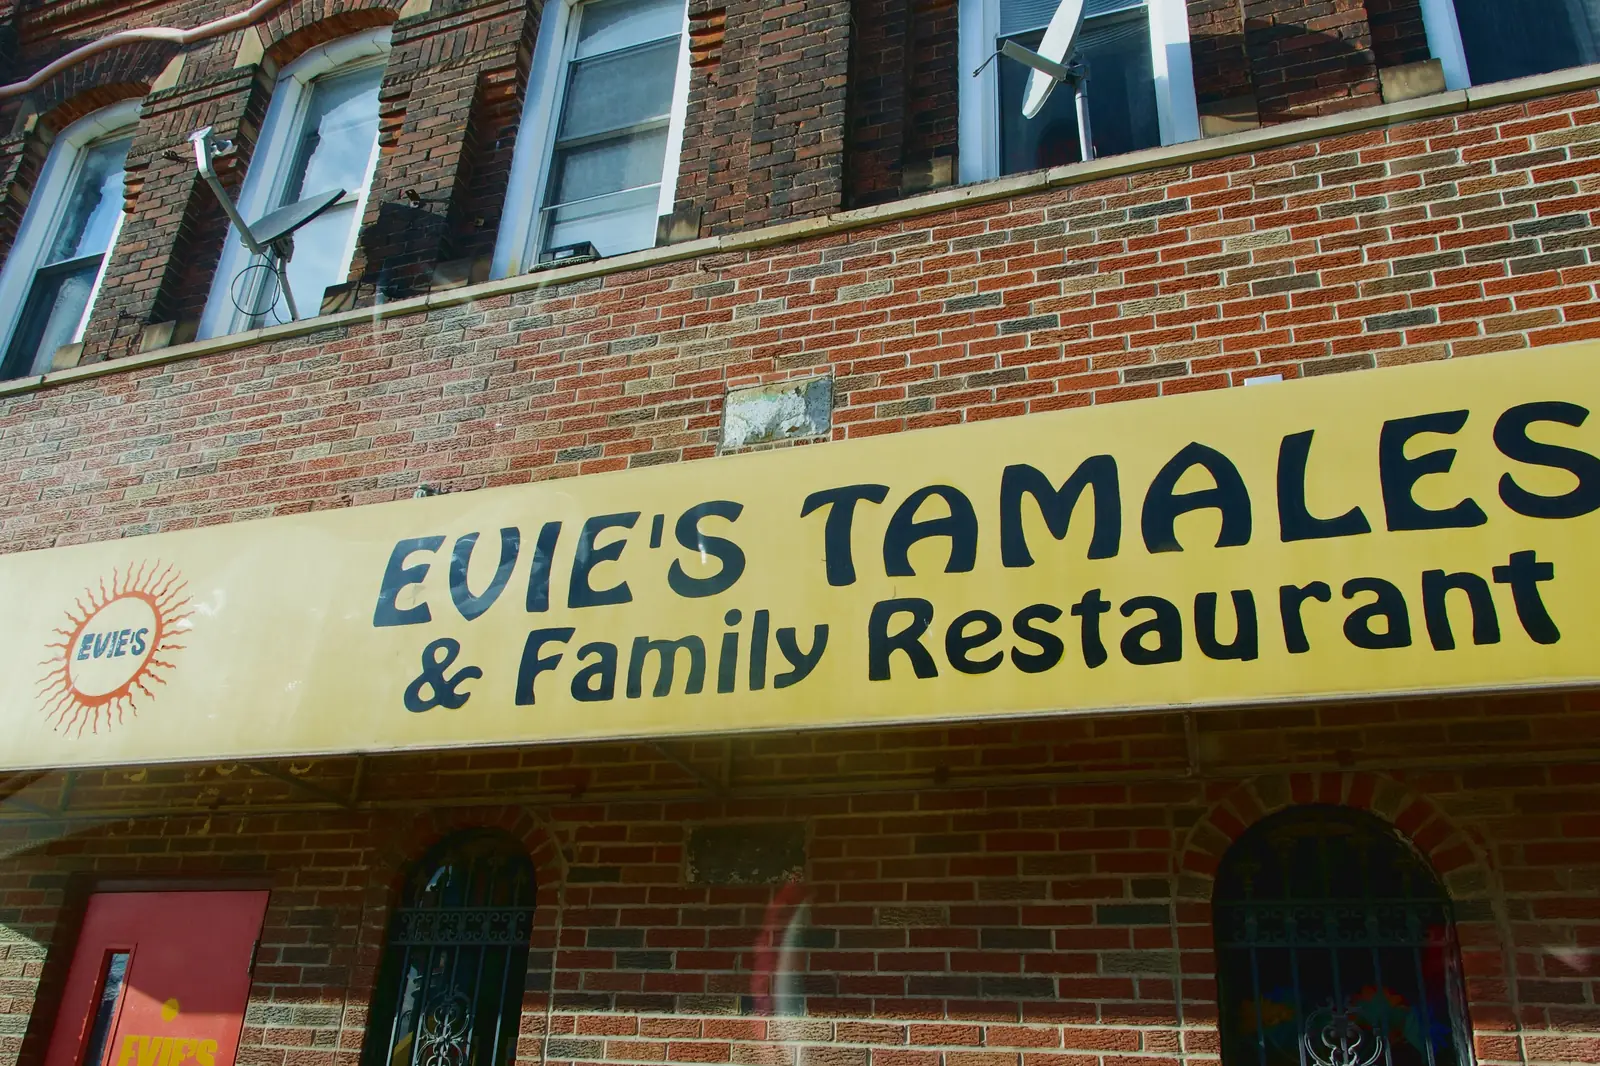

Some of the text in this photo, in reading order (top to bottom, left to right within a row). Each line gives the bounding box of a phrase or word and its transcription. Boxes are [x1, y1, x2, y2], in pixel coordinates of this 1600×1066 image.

[372, 401, 1600, 628] EVIE'S TAMALES
[77, 627, 149, 661] EVIE'S
[403, 550, 1561, 713] & Family Restaurant
